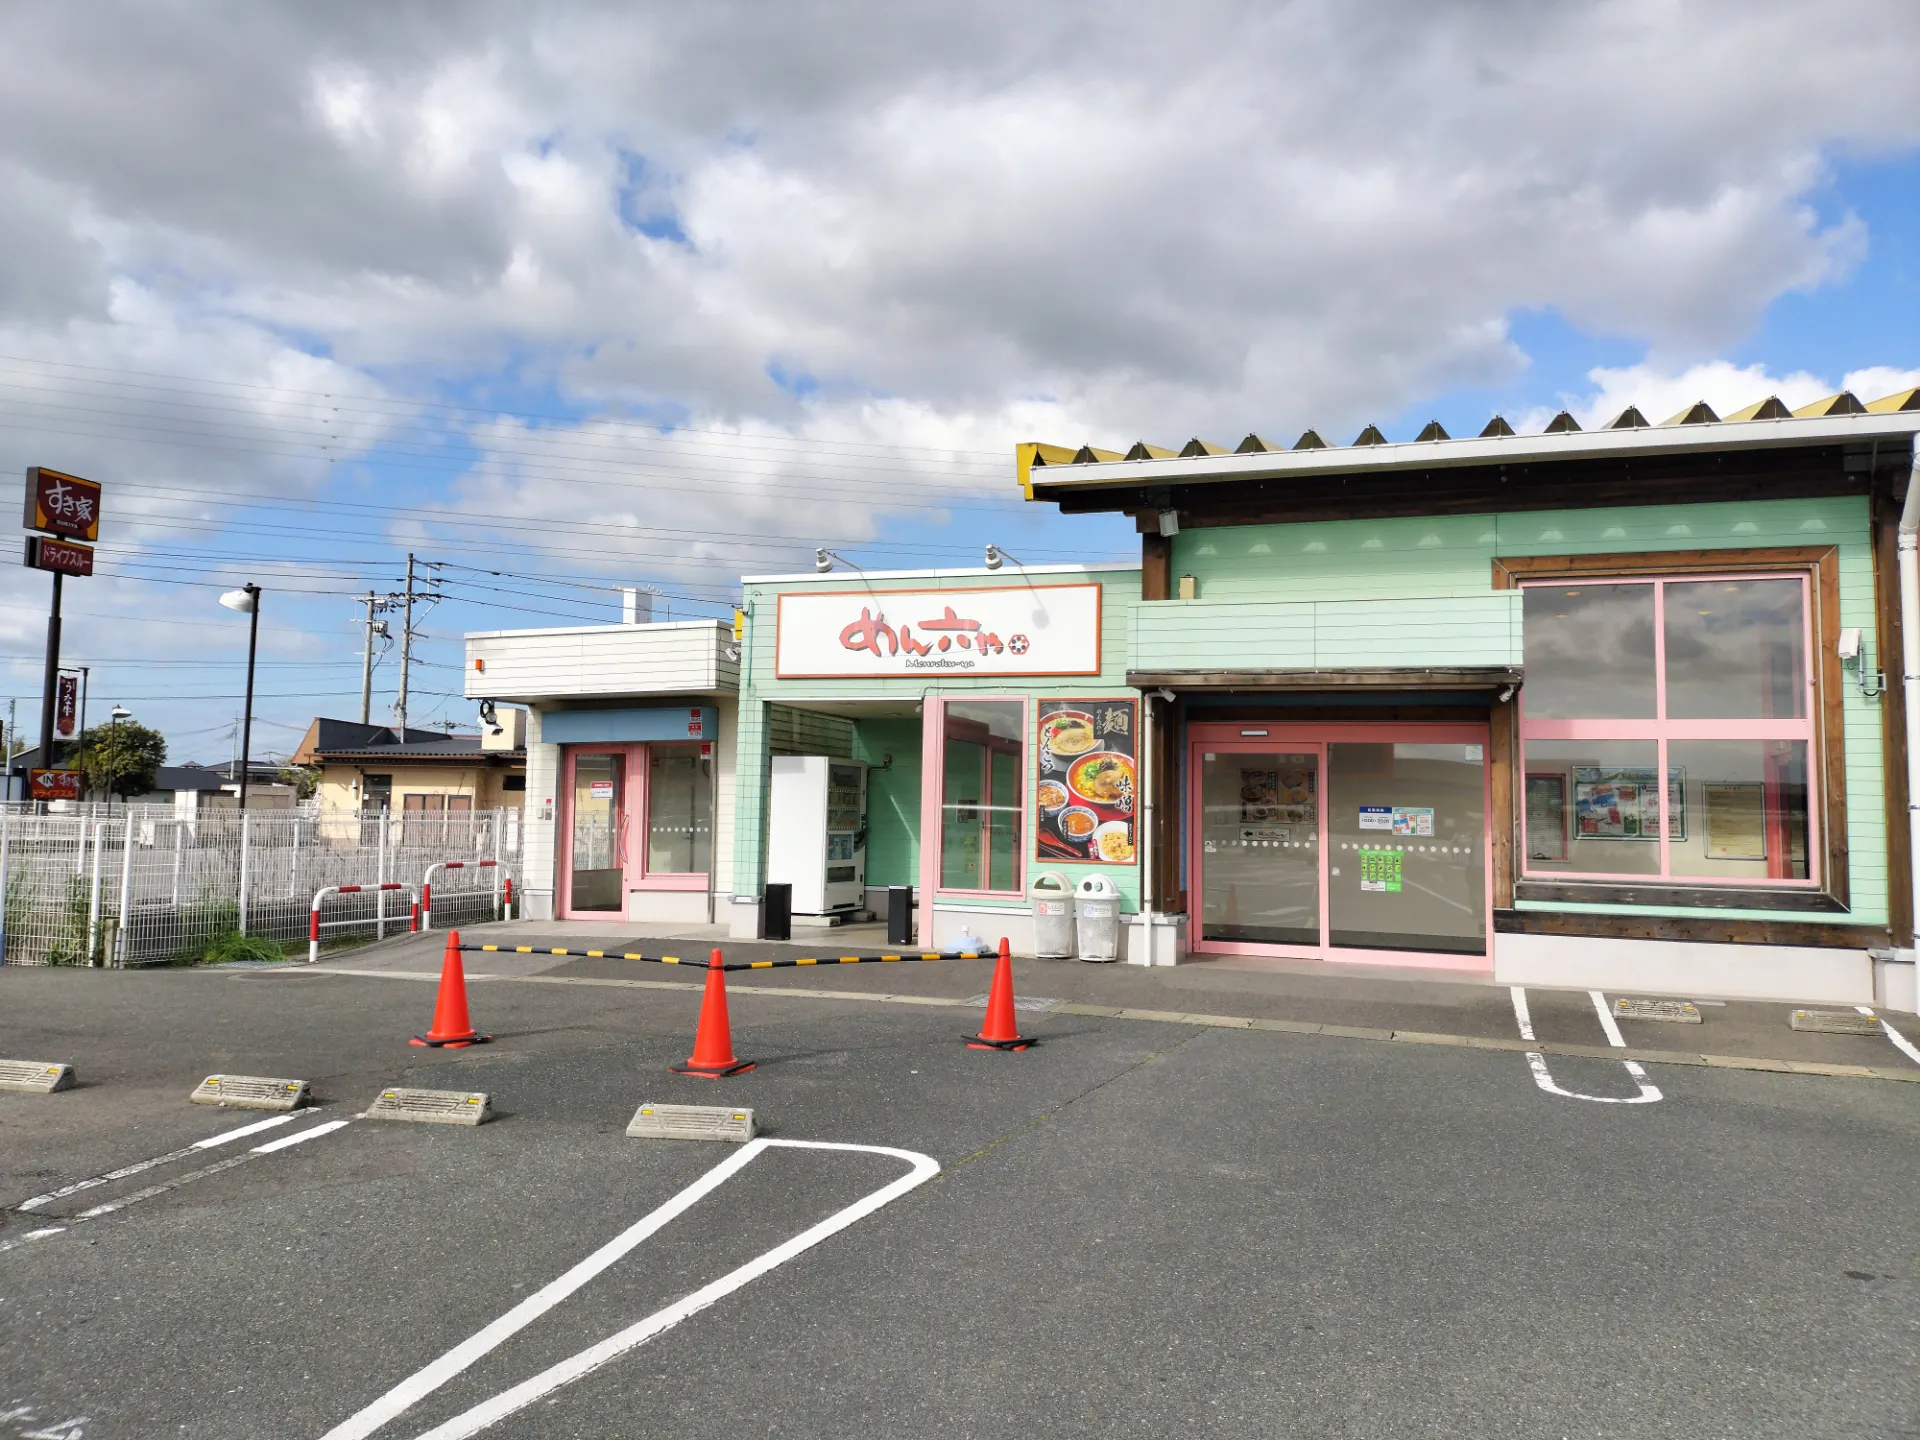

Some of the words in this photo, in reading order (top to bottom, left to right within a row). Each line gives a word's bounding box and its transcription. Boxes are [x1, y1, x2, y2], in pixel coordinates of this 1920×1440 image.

[45, 480, 93, 522] すき家
[43, 545, 91, 568] ドライブスルー
[62, 681, 74, 717] うな牛
[1042, 726, 1054, 775] とんこつ
[43, 775, 54, 785] IN
